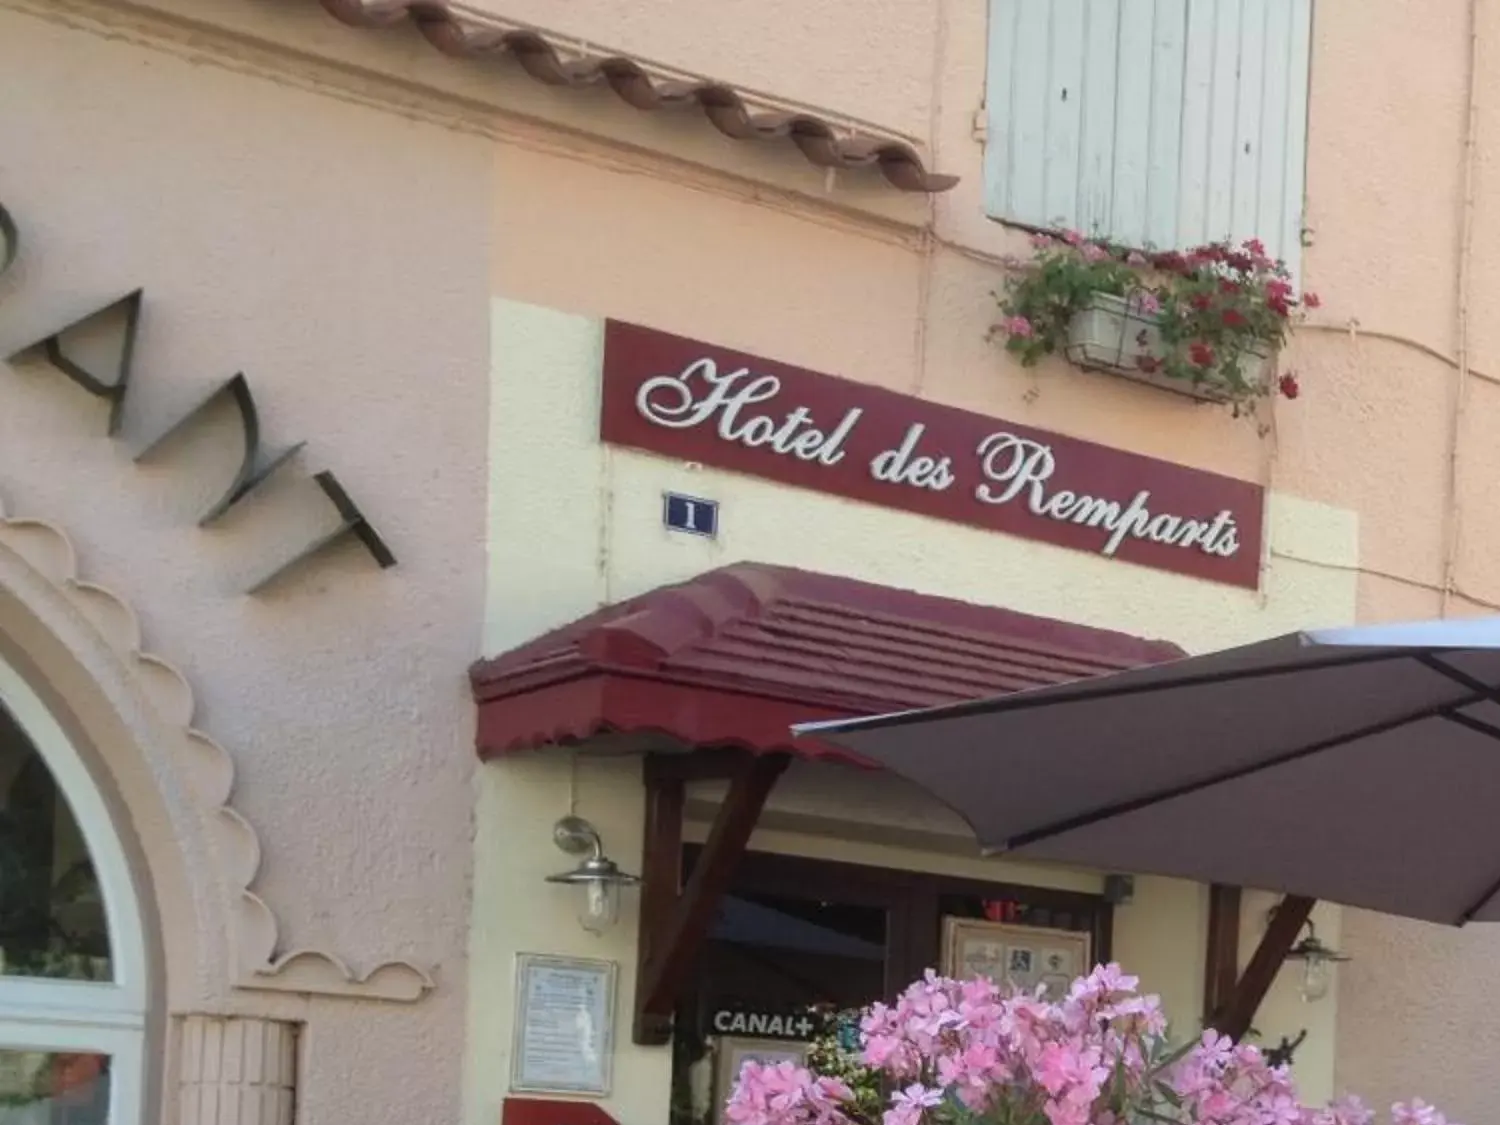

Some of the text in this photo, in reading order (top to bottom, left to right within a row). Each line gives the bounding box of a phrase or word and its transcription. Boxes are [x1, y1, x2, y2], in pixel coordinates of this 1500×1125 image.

[636, 357, 1240, 557] Hotel des Remparts
[685, 501, 698, 530] 1
[713, 1010, 815, 1037] CANAL+
